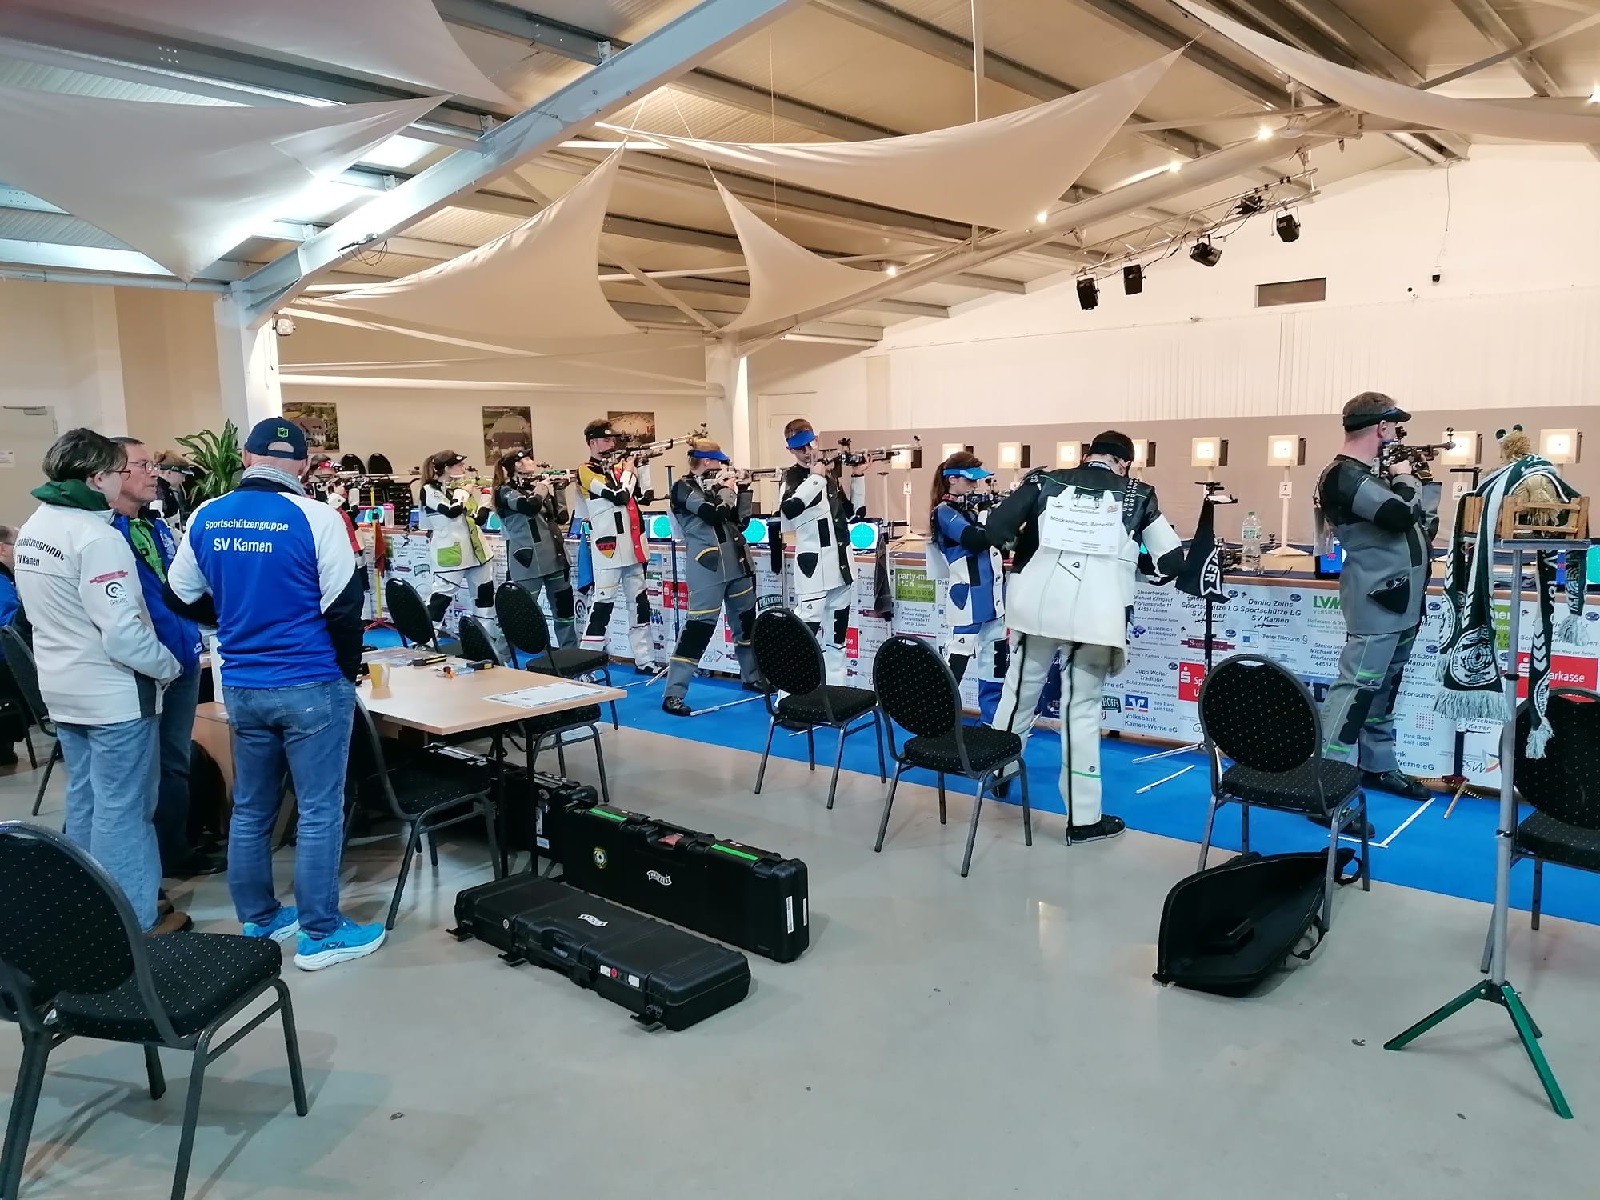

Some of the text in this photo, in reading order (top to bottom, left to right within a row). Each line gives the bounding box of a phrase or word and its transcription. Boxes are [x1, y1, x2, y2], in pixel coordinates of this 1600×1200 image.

[205, 518, 289, 532] Sportschützengruppe
[213, 537, 273, 553] SV Kamen
